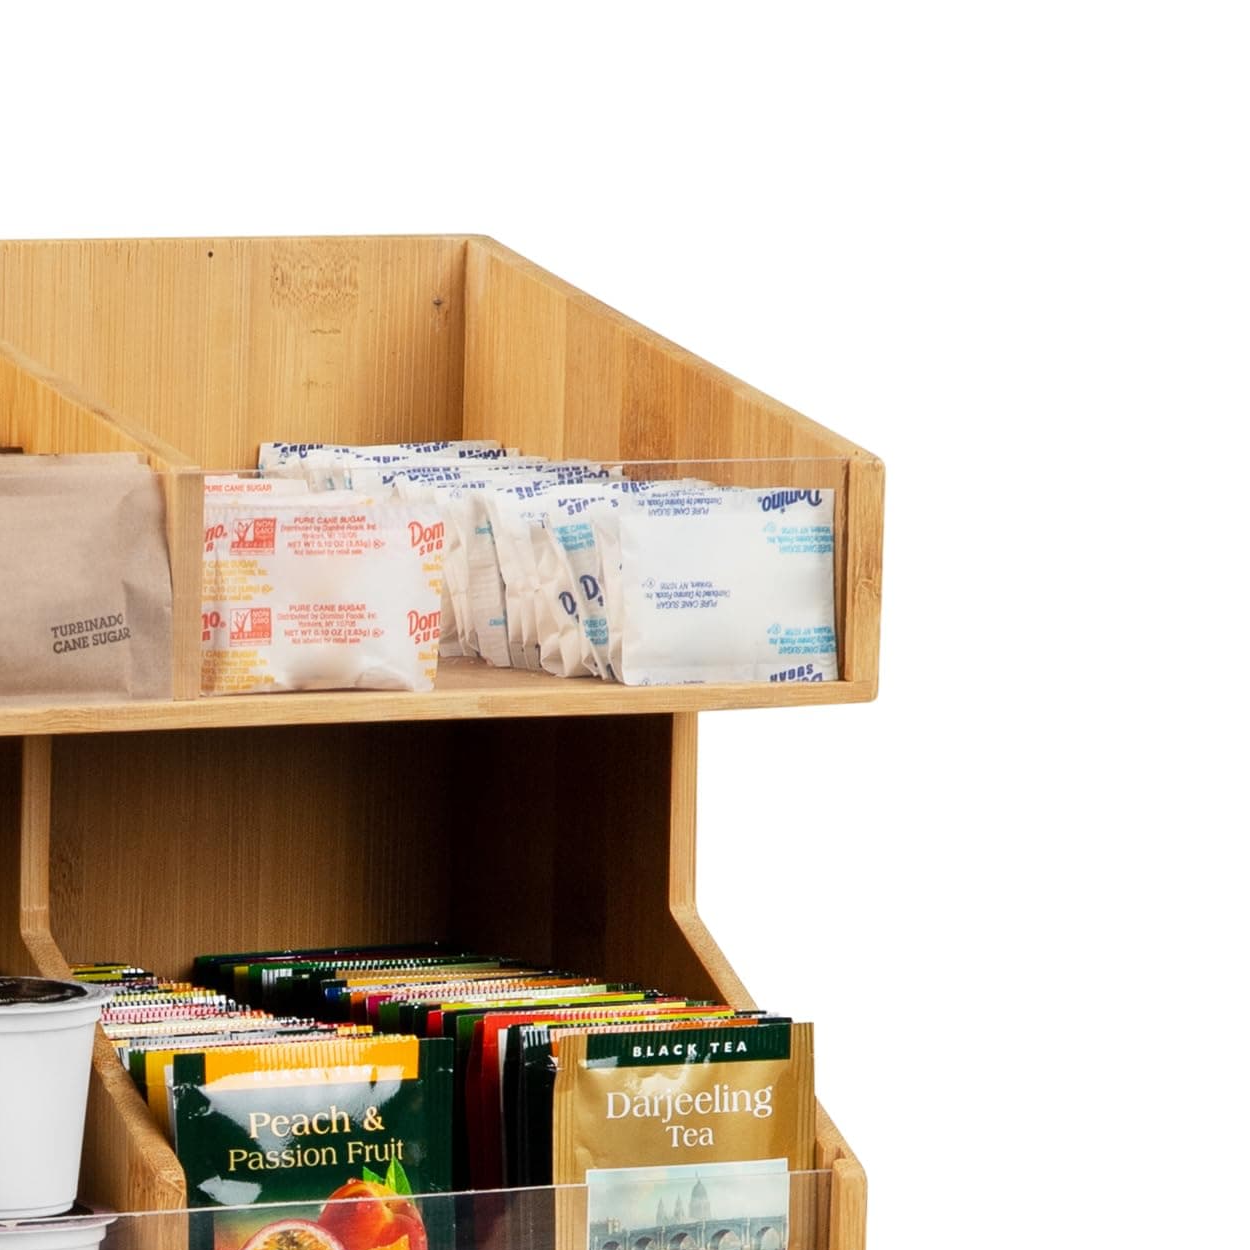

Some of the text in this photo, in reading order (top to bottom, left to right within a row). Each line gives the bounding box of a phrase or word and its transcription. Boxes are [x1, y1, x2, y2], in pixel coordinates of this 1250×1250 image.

[247, 484, 272, 492] SUGAR
[294, 515, 366, 525] PURE CANE SUGAR
[289, 604, 366, 612] PURE CANE SUGAR
[656, 601, 680, 609] SUGAR
[681, 600, 699, 608] CANE
[51, 613, 124, 639] TURBINADO
[53, 627, 131, 654] CANE SUGAR
[632, 1041, 748, 1058] BLACK TEA
[606, 1083, 774, 1123] Darjeeling
[249, 1105, 386, 1139] Peach &
[665, 1125, 715, 1148] Tea
[228, 1138, 404, 1172] Passion Fruit
